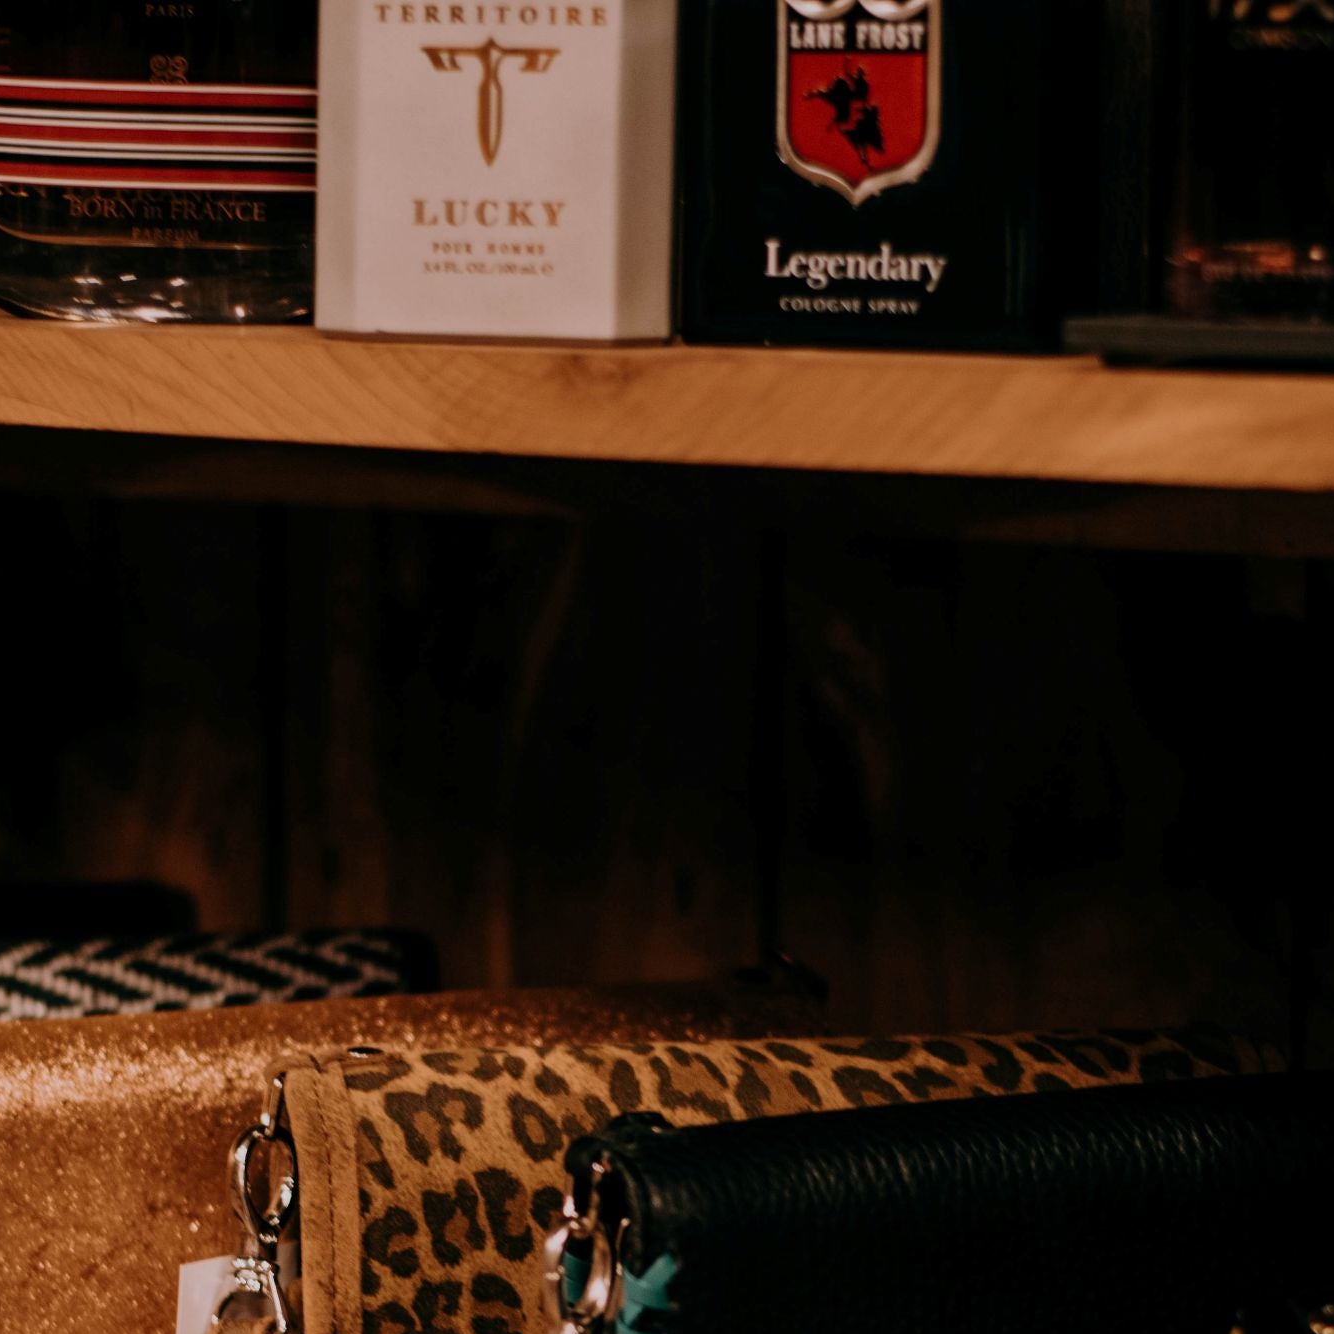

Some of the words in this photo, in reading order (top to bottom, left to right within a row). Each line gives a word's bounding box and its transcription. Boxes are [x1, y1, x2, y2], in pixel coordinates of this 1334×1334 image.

[376, 4, 608, 26] TERRITOIRE
[789, 21, 845, 49] LANE
[855, 22, 925, 50] FROST
[68, 198, 136, 219] BORN
[169, 201, 267, 223] FRANCE
[412, 198, 567, 228] LUCKY
[764, 236, 948, 294] Legendary
[779, 297, 862, 314] COLOGNE
[867, 299, 920, 315] SPRAY
